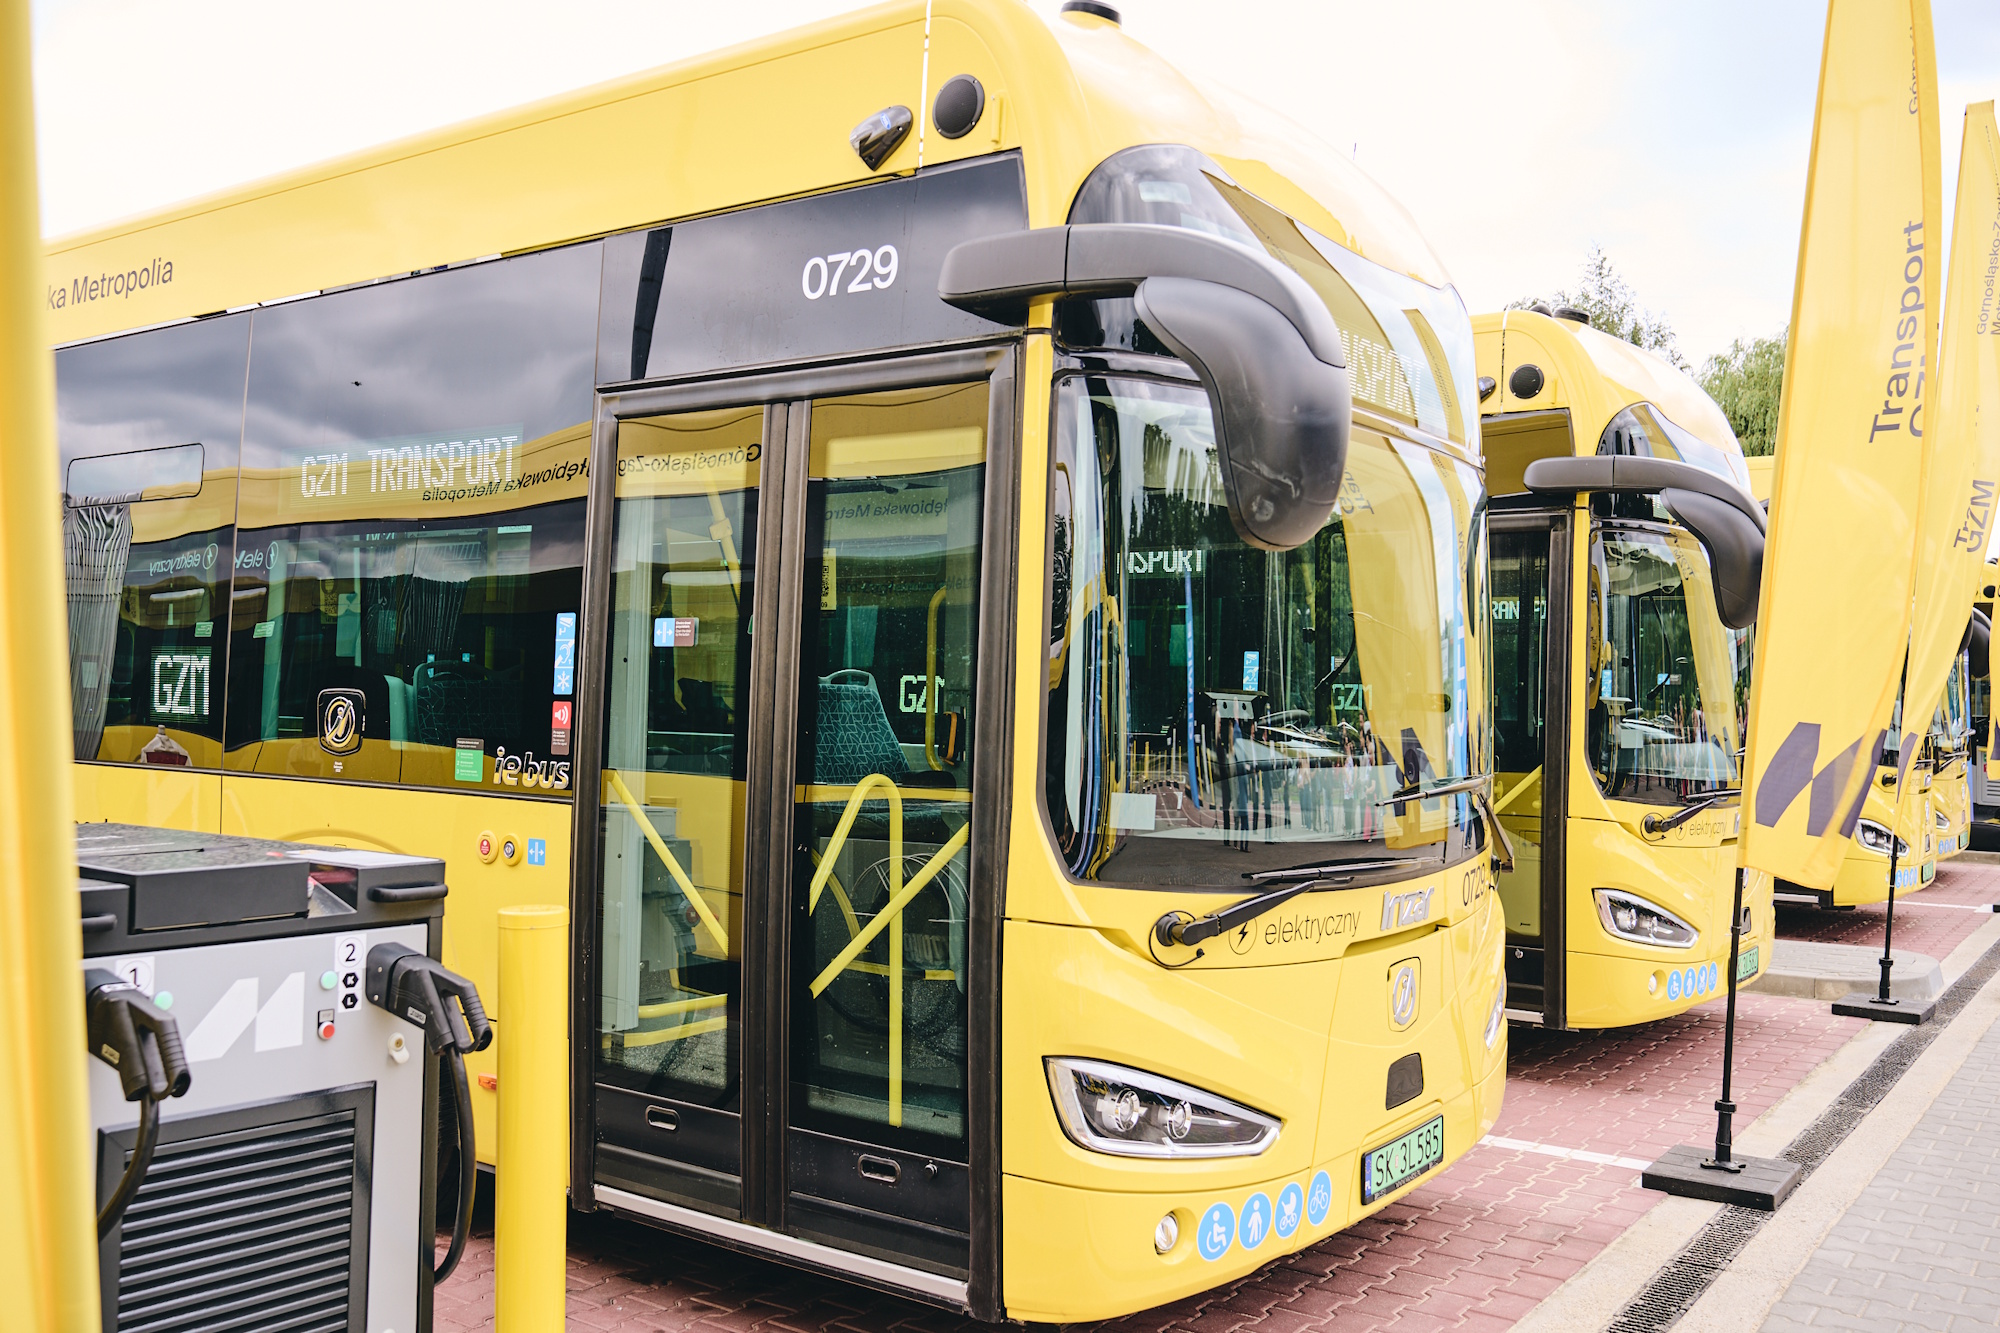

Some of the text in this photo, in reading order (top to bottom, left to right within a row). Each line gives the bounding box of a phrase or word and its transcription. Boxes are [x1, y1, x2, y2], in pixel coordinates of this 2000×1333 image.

[71, 257, 173, 306] Metropolia
[802, 244, 899, 300] 0729
[1868, 220, 1925, 444] Transport
[301, 436, 518, 498] GZM TRANSPORT
[1953, 521, 1969, 548] Tr
[154, 655, 210, 715] GZM
[1463, 862, 1486, 906] 0729
[1265, 910, 1361, 945] elektryczny
[345, 943, 356, 962] 2
[129, 967, 141, 988] 1
[1376, 1147, 1394, 1187] SK
[1400, 1123, 1439, 1174] 3L585
